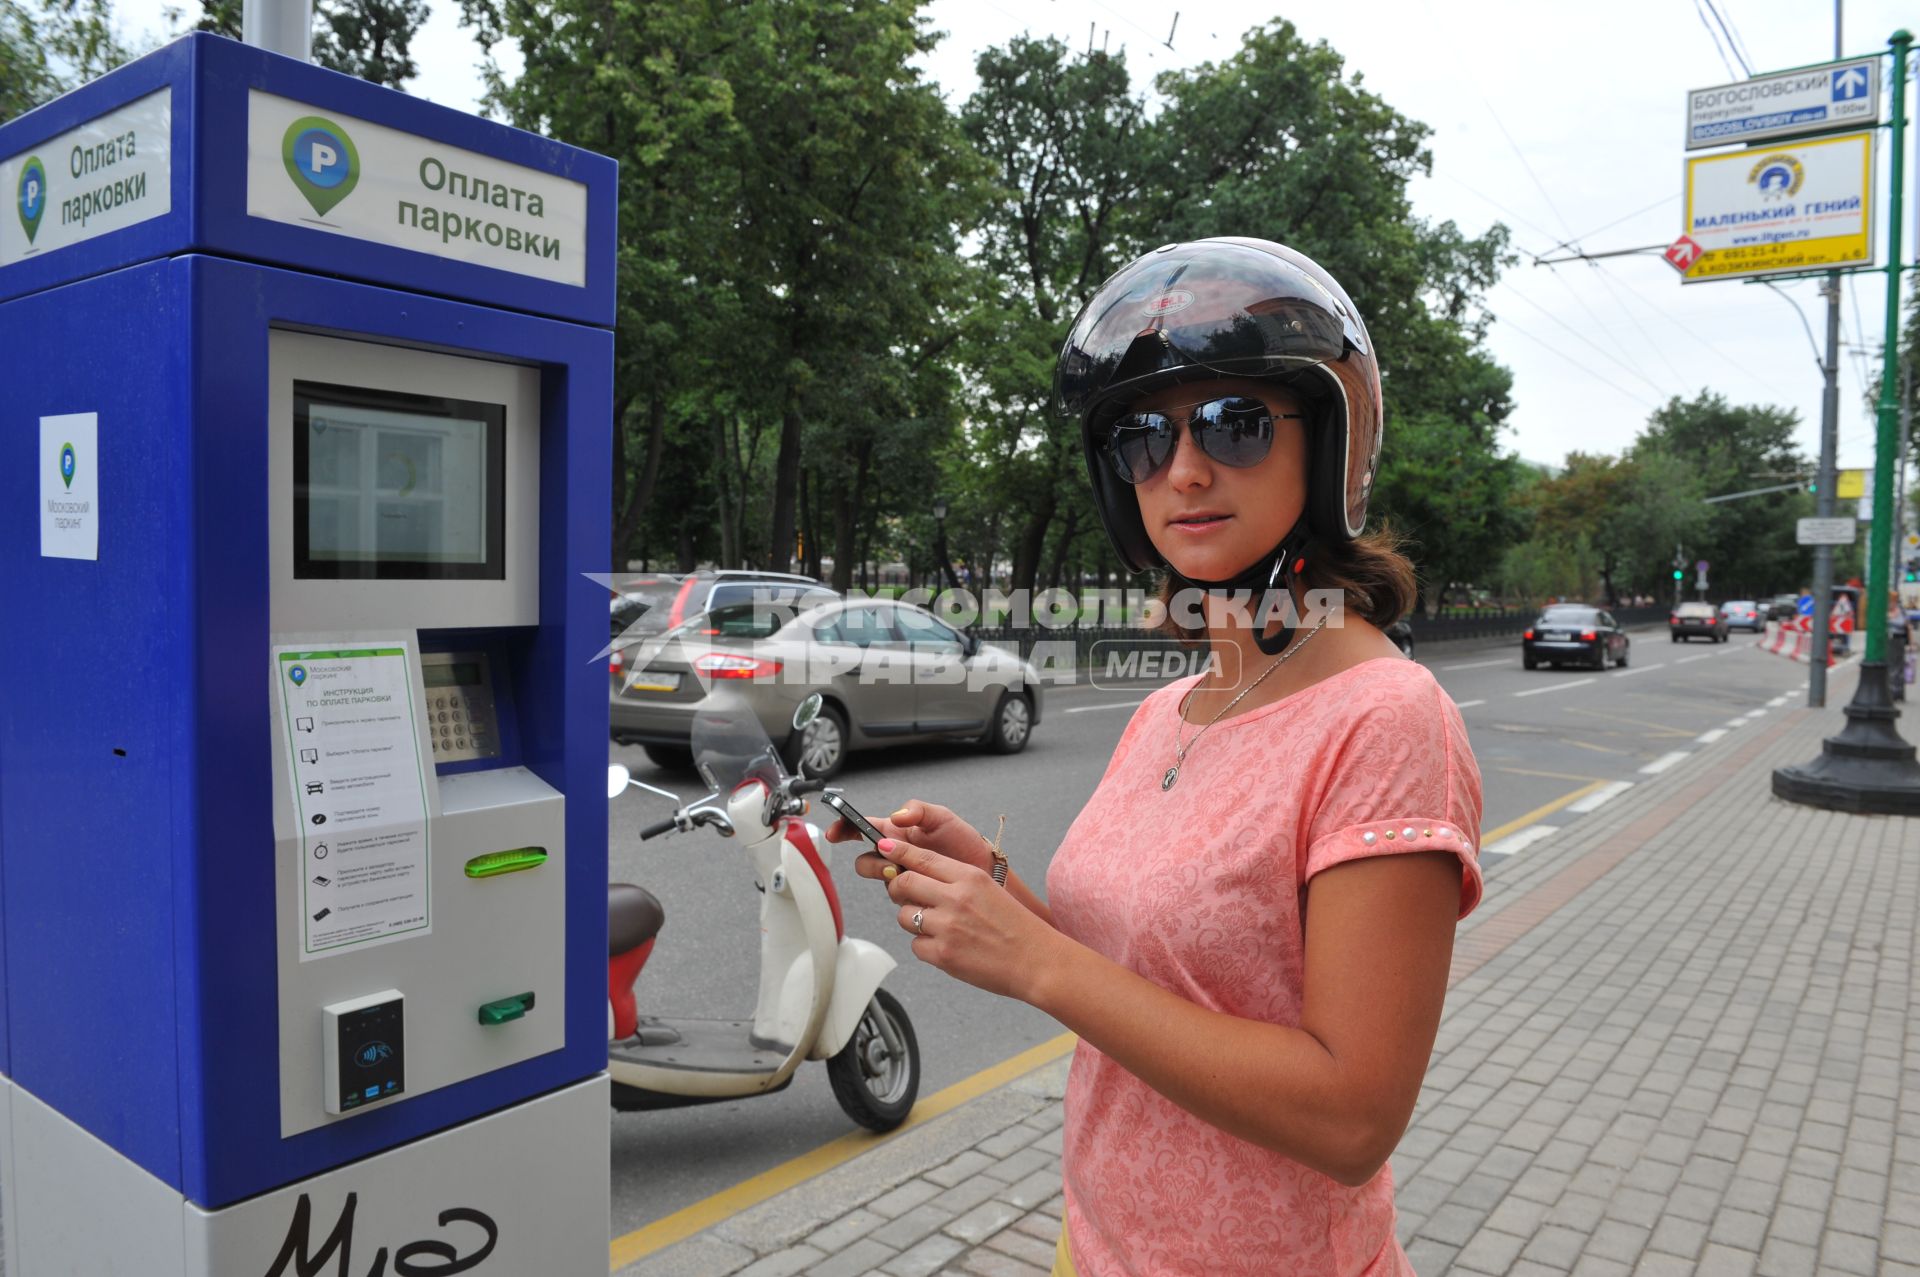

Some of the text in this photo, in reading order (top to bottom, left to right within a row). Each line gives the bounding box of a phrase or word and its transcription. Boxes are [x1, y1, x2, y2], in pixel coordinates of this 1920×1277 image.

[1693, 74, 1829, 110] БОГОСЛОВСКИЙ
[71, 130, 136, 180] Оплата
[311, 141, 337, 174] P
[61, 170, 147, 227] парковки
[418, 156, 545, 219] Оплата
[1694, 204, 1796, 229] МАЛЕНЬКИЙ
[1804, 197, 1860, 215] ГЕНИЙ
[398, 201, 561, 261] парковки
[48, 500, 90, 513] Московский
[55, 517, 82, 531] паркинг
[310, 665, 352, 673] Московский
[310, 673, 338, 681] паркинг
[306, 695, 392, 708] ПО ОПЛАТЕ ПАРКОВКИ
[323, 687, 374, 697] ИНСТРУКЦИЯ
